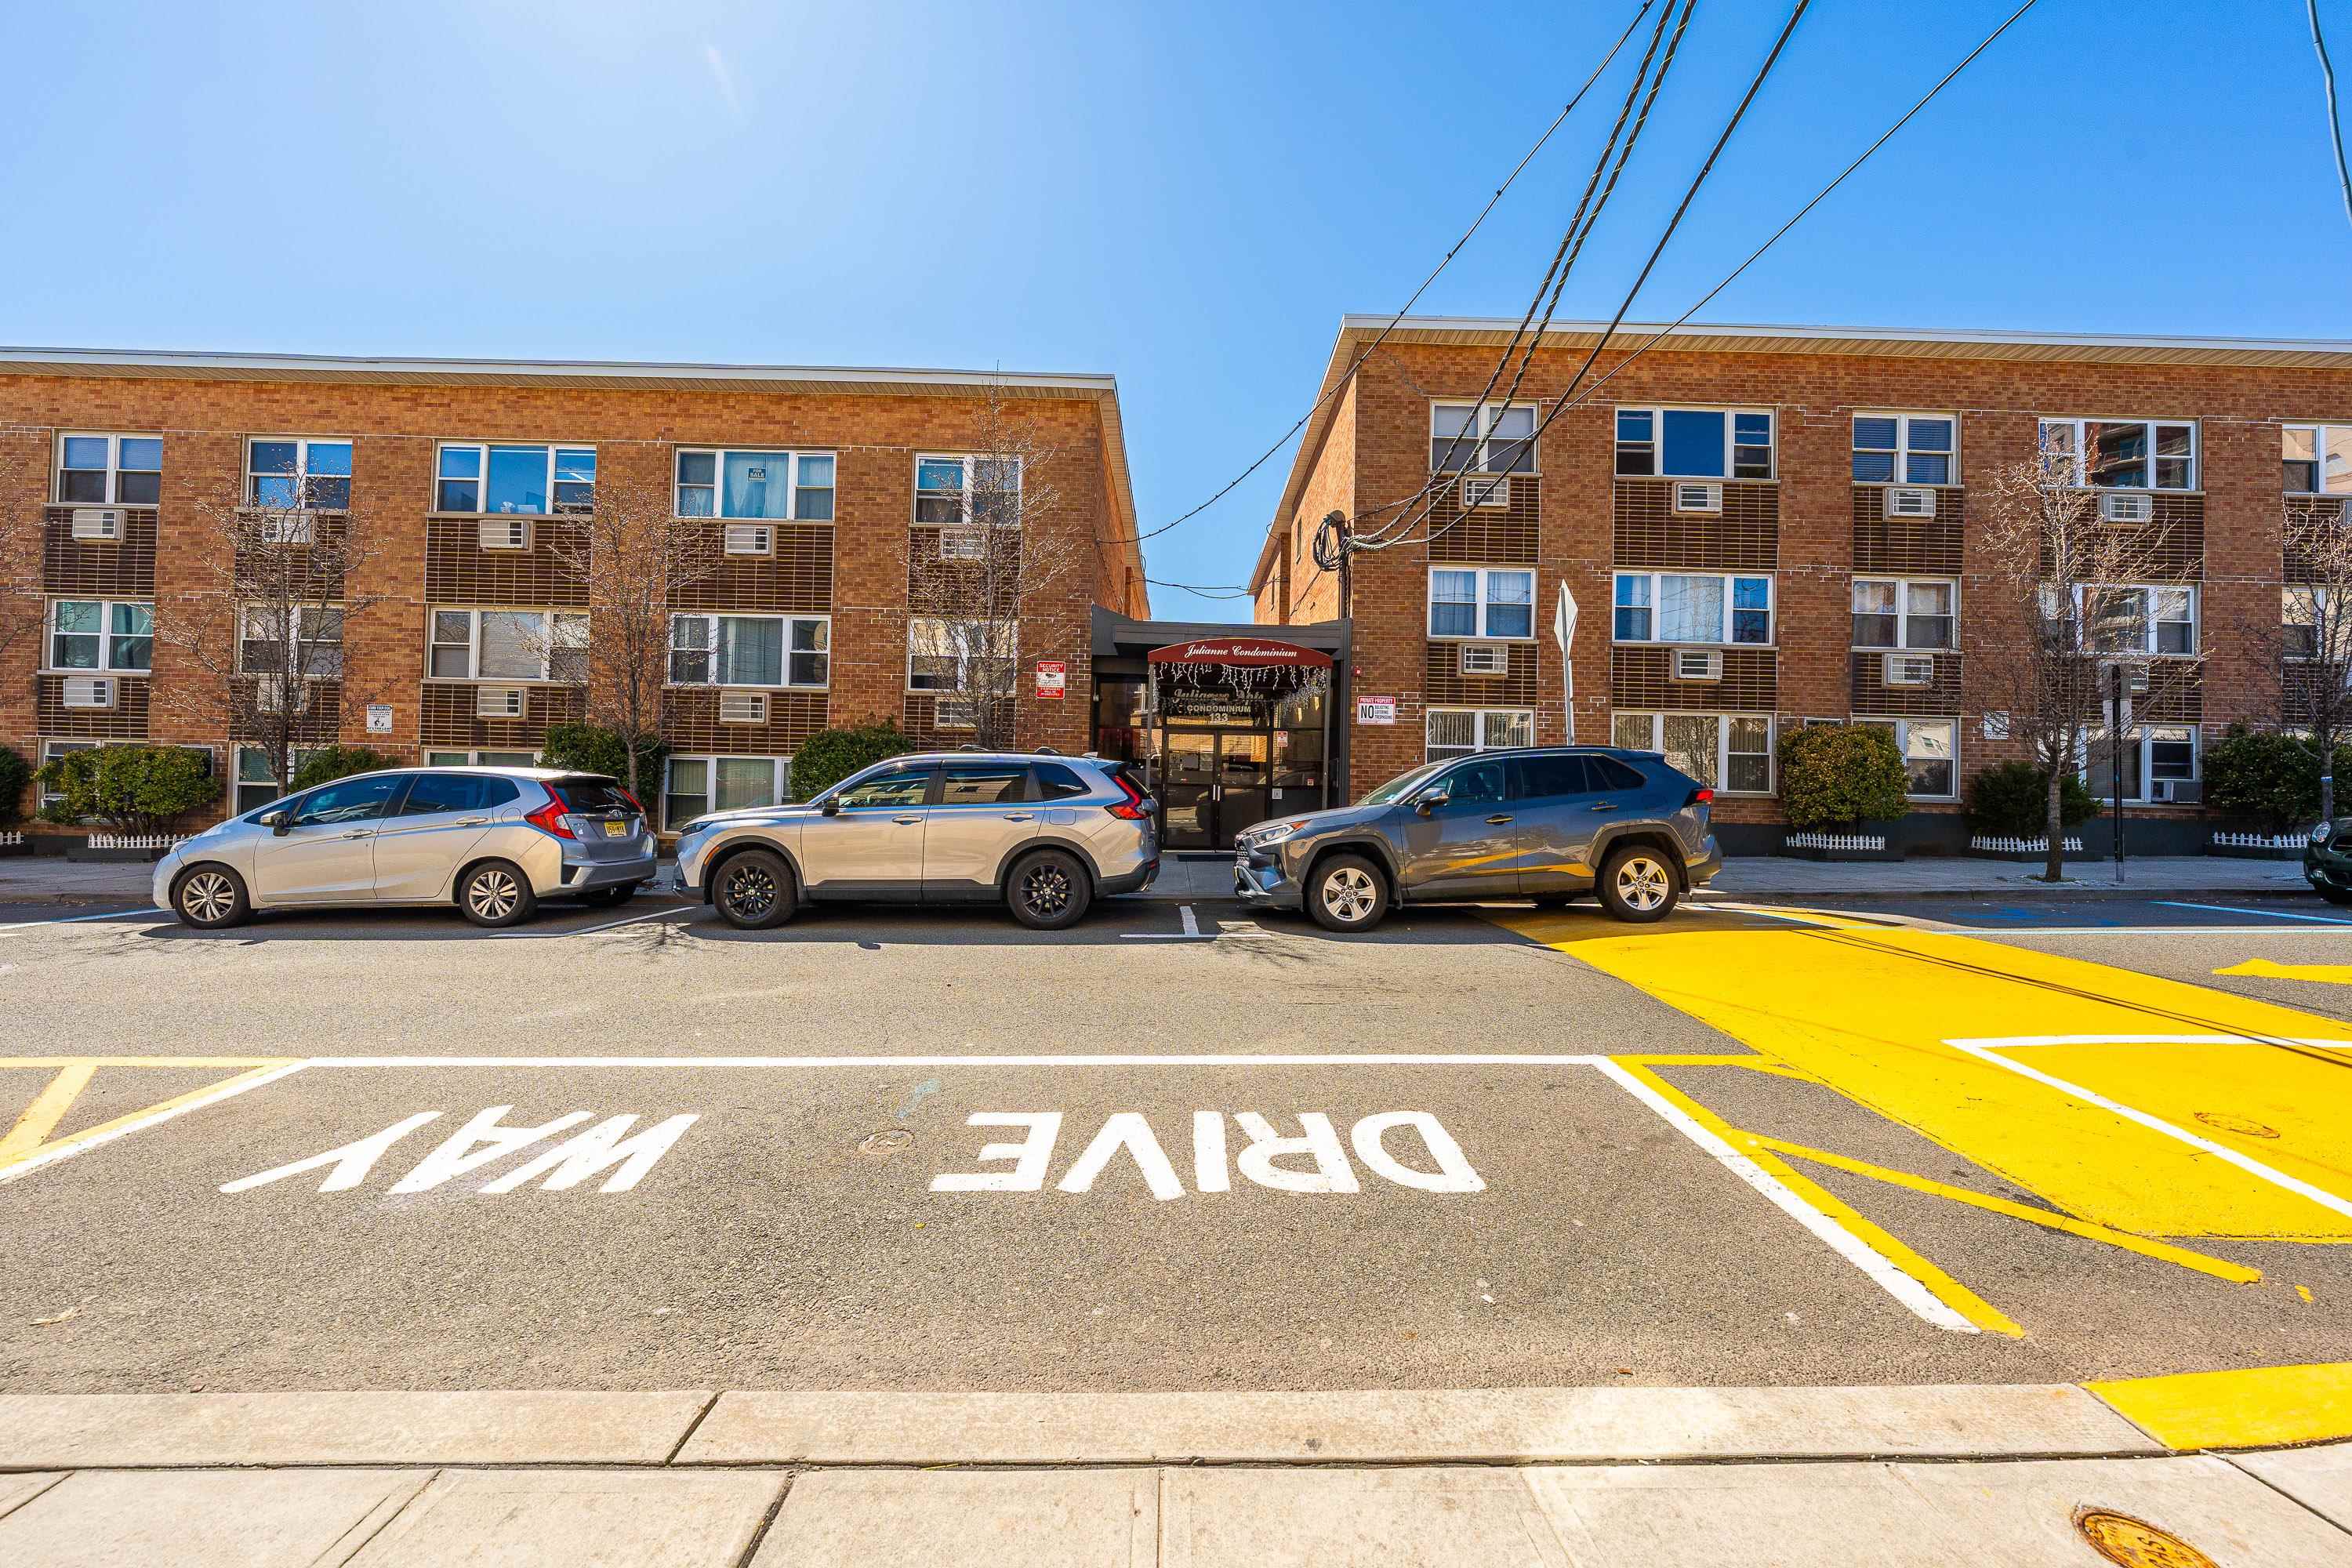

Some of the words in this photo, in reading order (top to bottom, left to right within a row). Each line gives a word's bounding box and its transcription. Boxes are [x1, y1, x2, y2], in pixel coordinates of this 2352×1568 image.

[1184, 644, 1229, 658] Julianne
[1232, 645, 1298, 657] Condominium
[1209, 713, 1229, 722] 133
[1361, 706, 1374, 718] NO
[220, 1105, 701, 1194] WAY
[930, 1109, 1487, 1201] DRIVE
